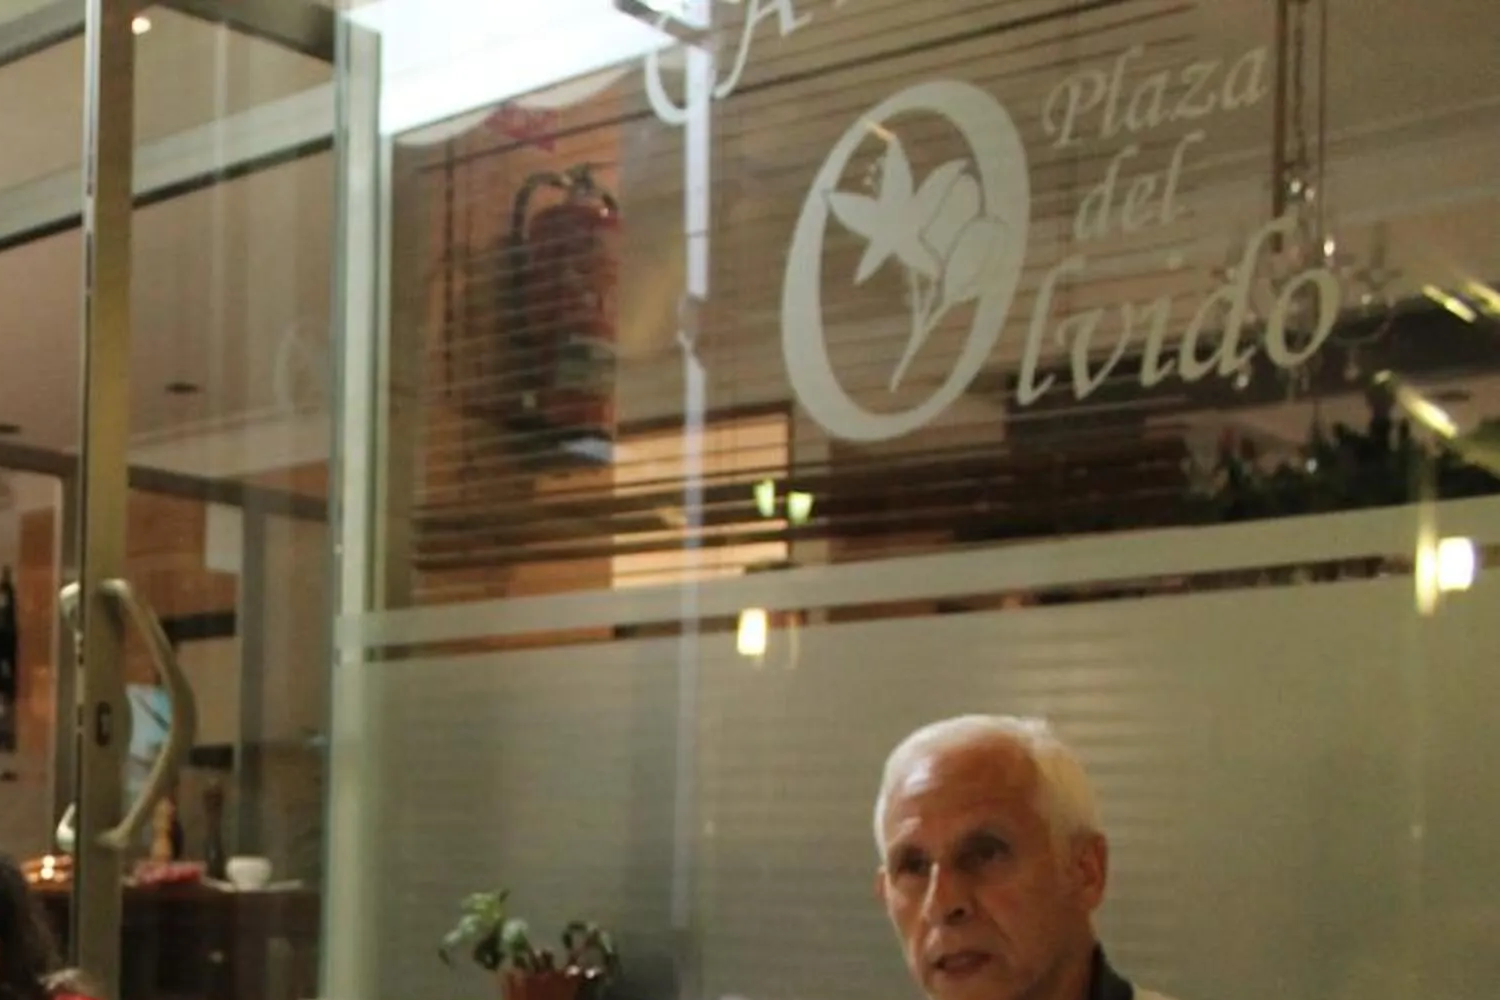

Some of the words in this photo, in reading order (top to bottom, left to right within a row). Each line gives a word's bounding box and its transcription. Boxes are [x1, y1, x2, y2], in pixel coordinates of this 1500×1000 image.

[1042, 44, 1268, 147] Plaza
[1073, 129, 1205, 240] del
[781, 79, 1342, 441] Olvido
